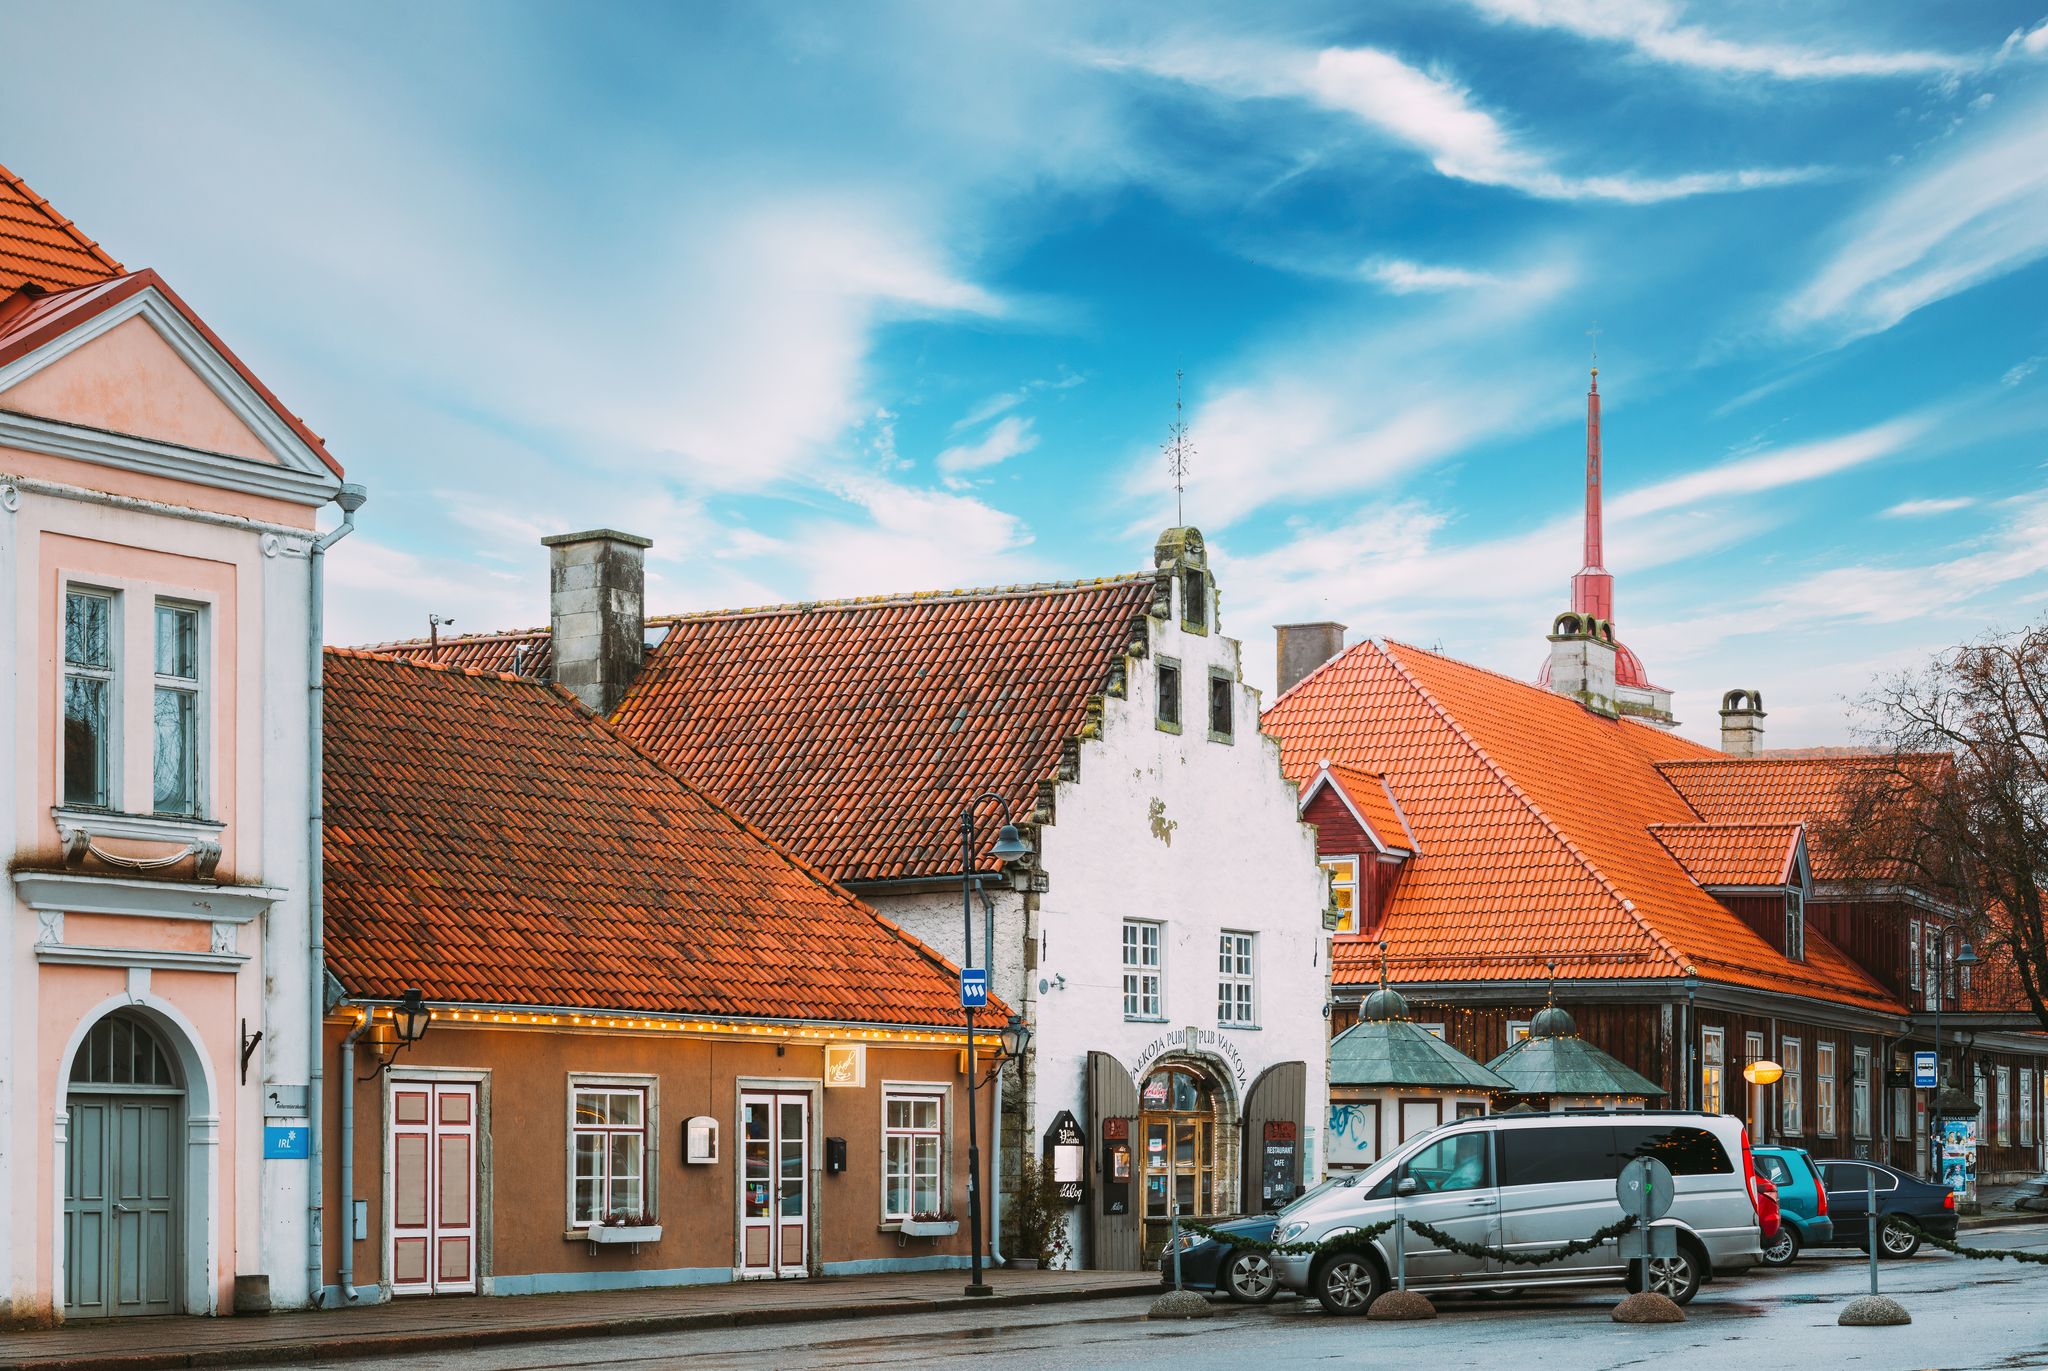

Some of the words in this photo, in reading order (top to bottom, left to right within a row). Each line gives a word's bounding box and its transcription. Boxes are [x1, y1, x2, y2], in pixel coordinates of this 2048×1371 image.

[1167, 1029, 1185, 1046] PUBI
[1199, 1030, 1215, 1044] PUB
[1218, 1033, 1247, 1090] VAEKOJA
[278, 1139, 291, 1148] IRL
[1267, 1146, 1293, 1154] RESTAURANT
[1274, 1159, 1285, 1167] CAFE
[1277, 1171, 1282, 1179] &
[1275, 1184, 1284, 1192] BAR
